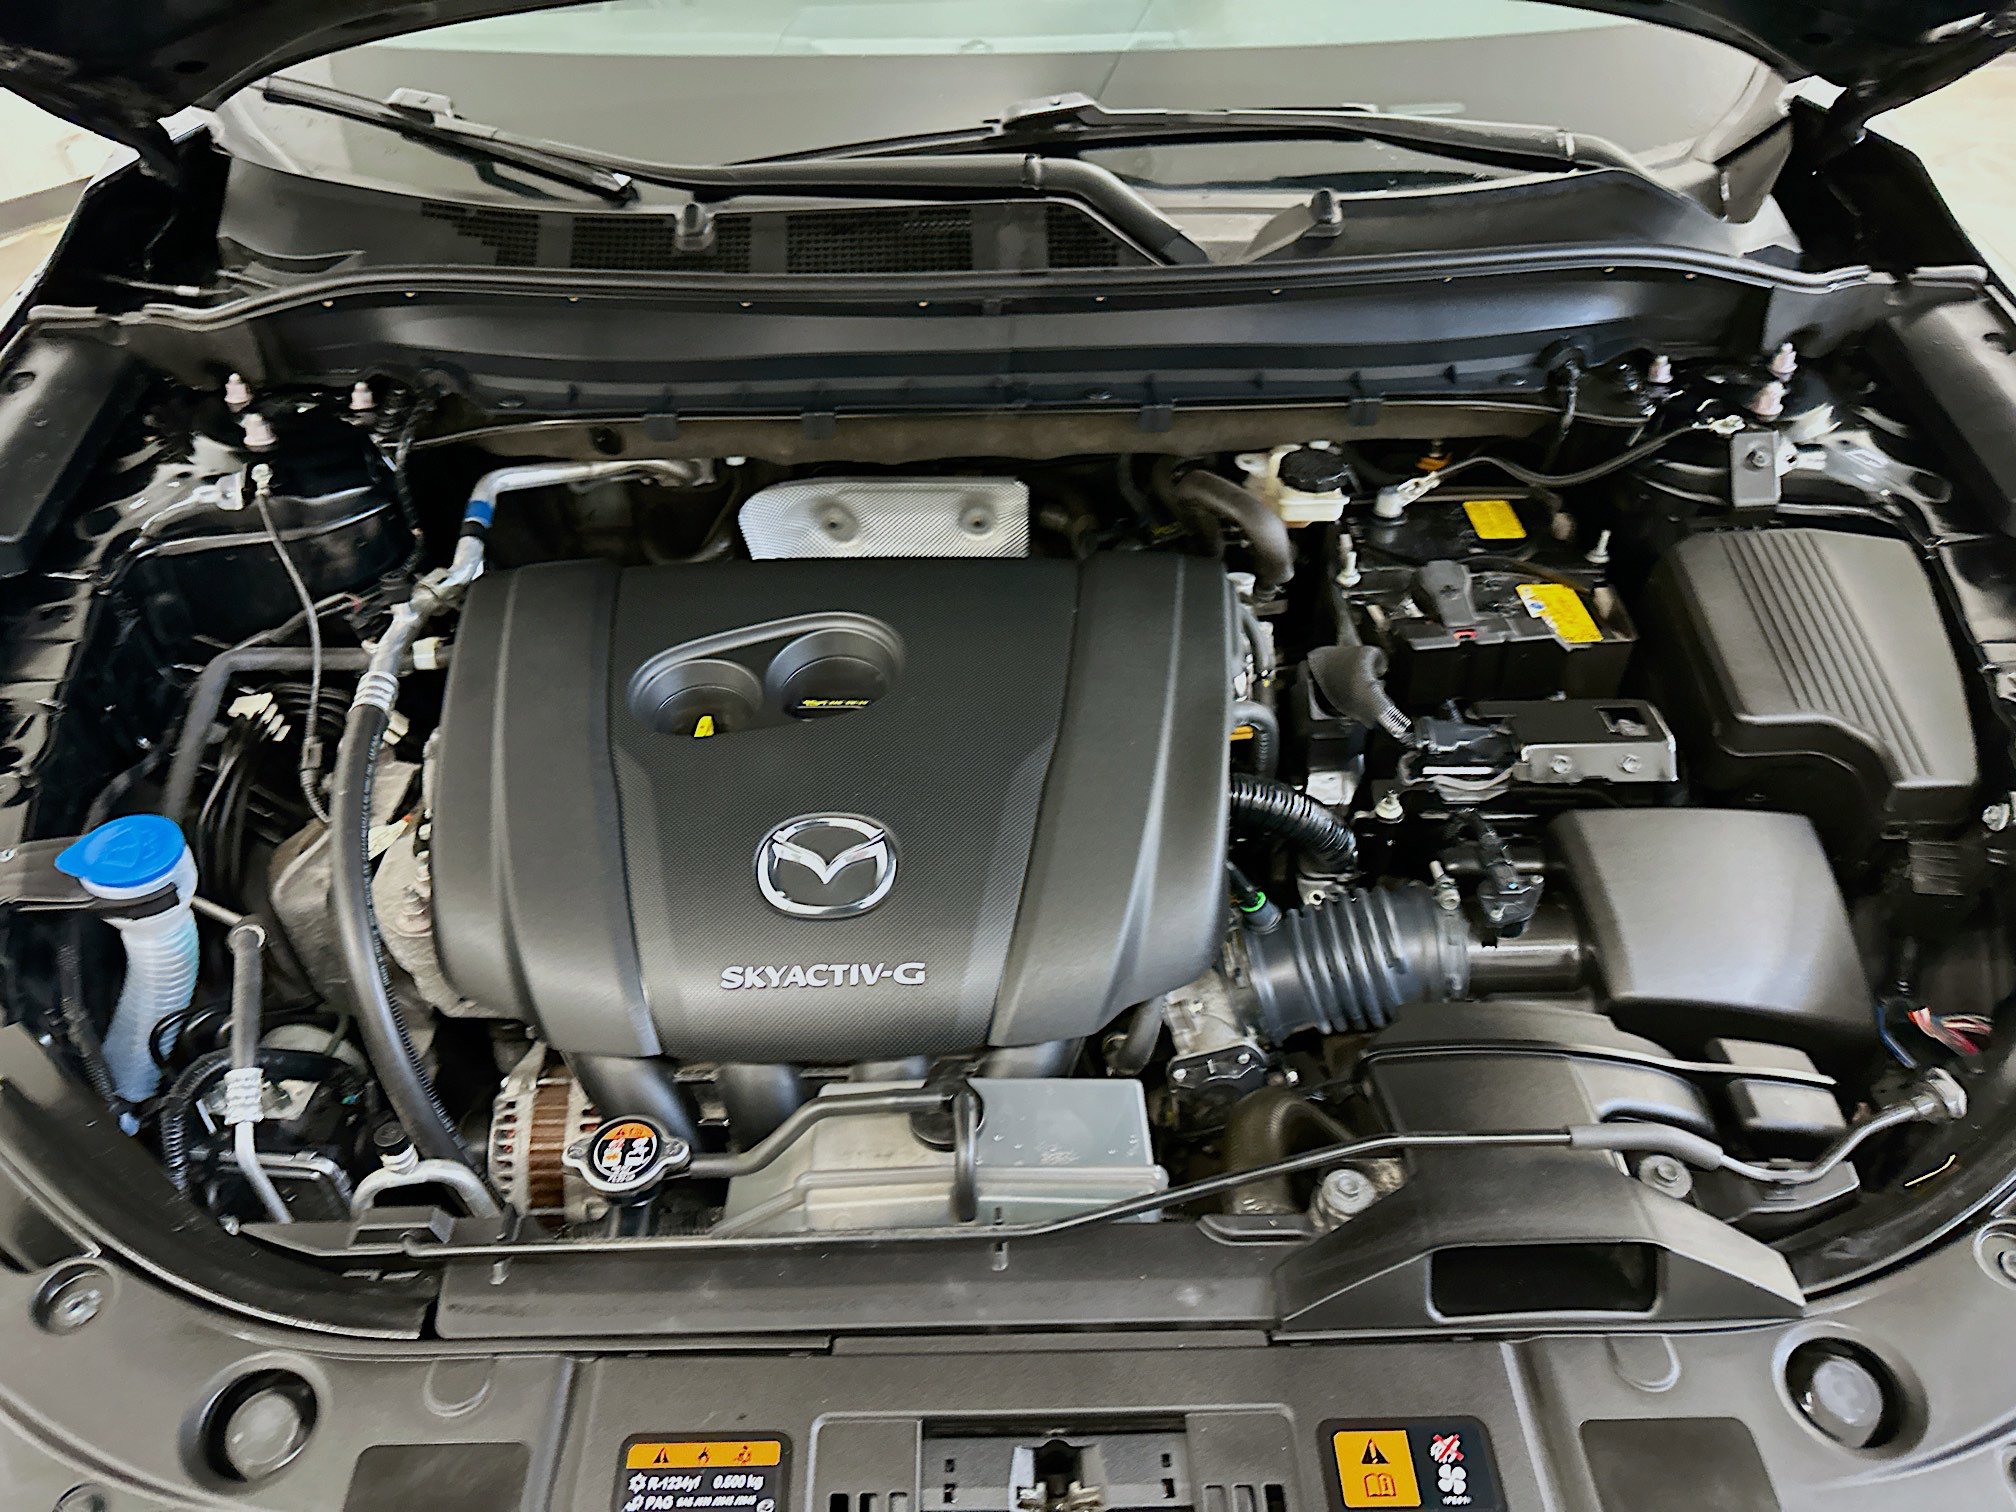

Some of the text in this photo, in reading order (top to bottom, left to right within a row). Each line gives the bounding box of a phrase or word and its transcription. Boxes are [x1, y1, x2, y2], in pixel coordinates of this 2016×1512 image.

[720, 962, 926, 990] SKYACTIV-G
[747, 1474, 764, 1491] kg
[644, 1495, 674, 1511] PAG
